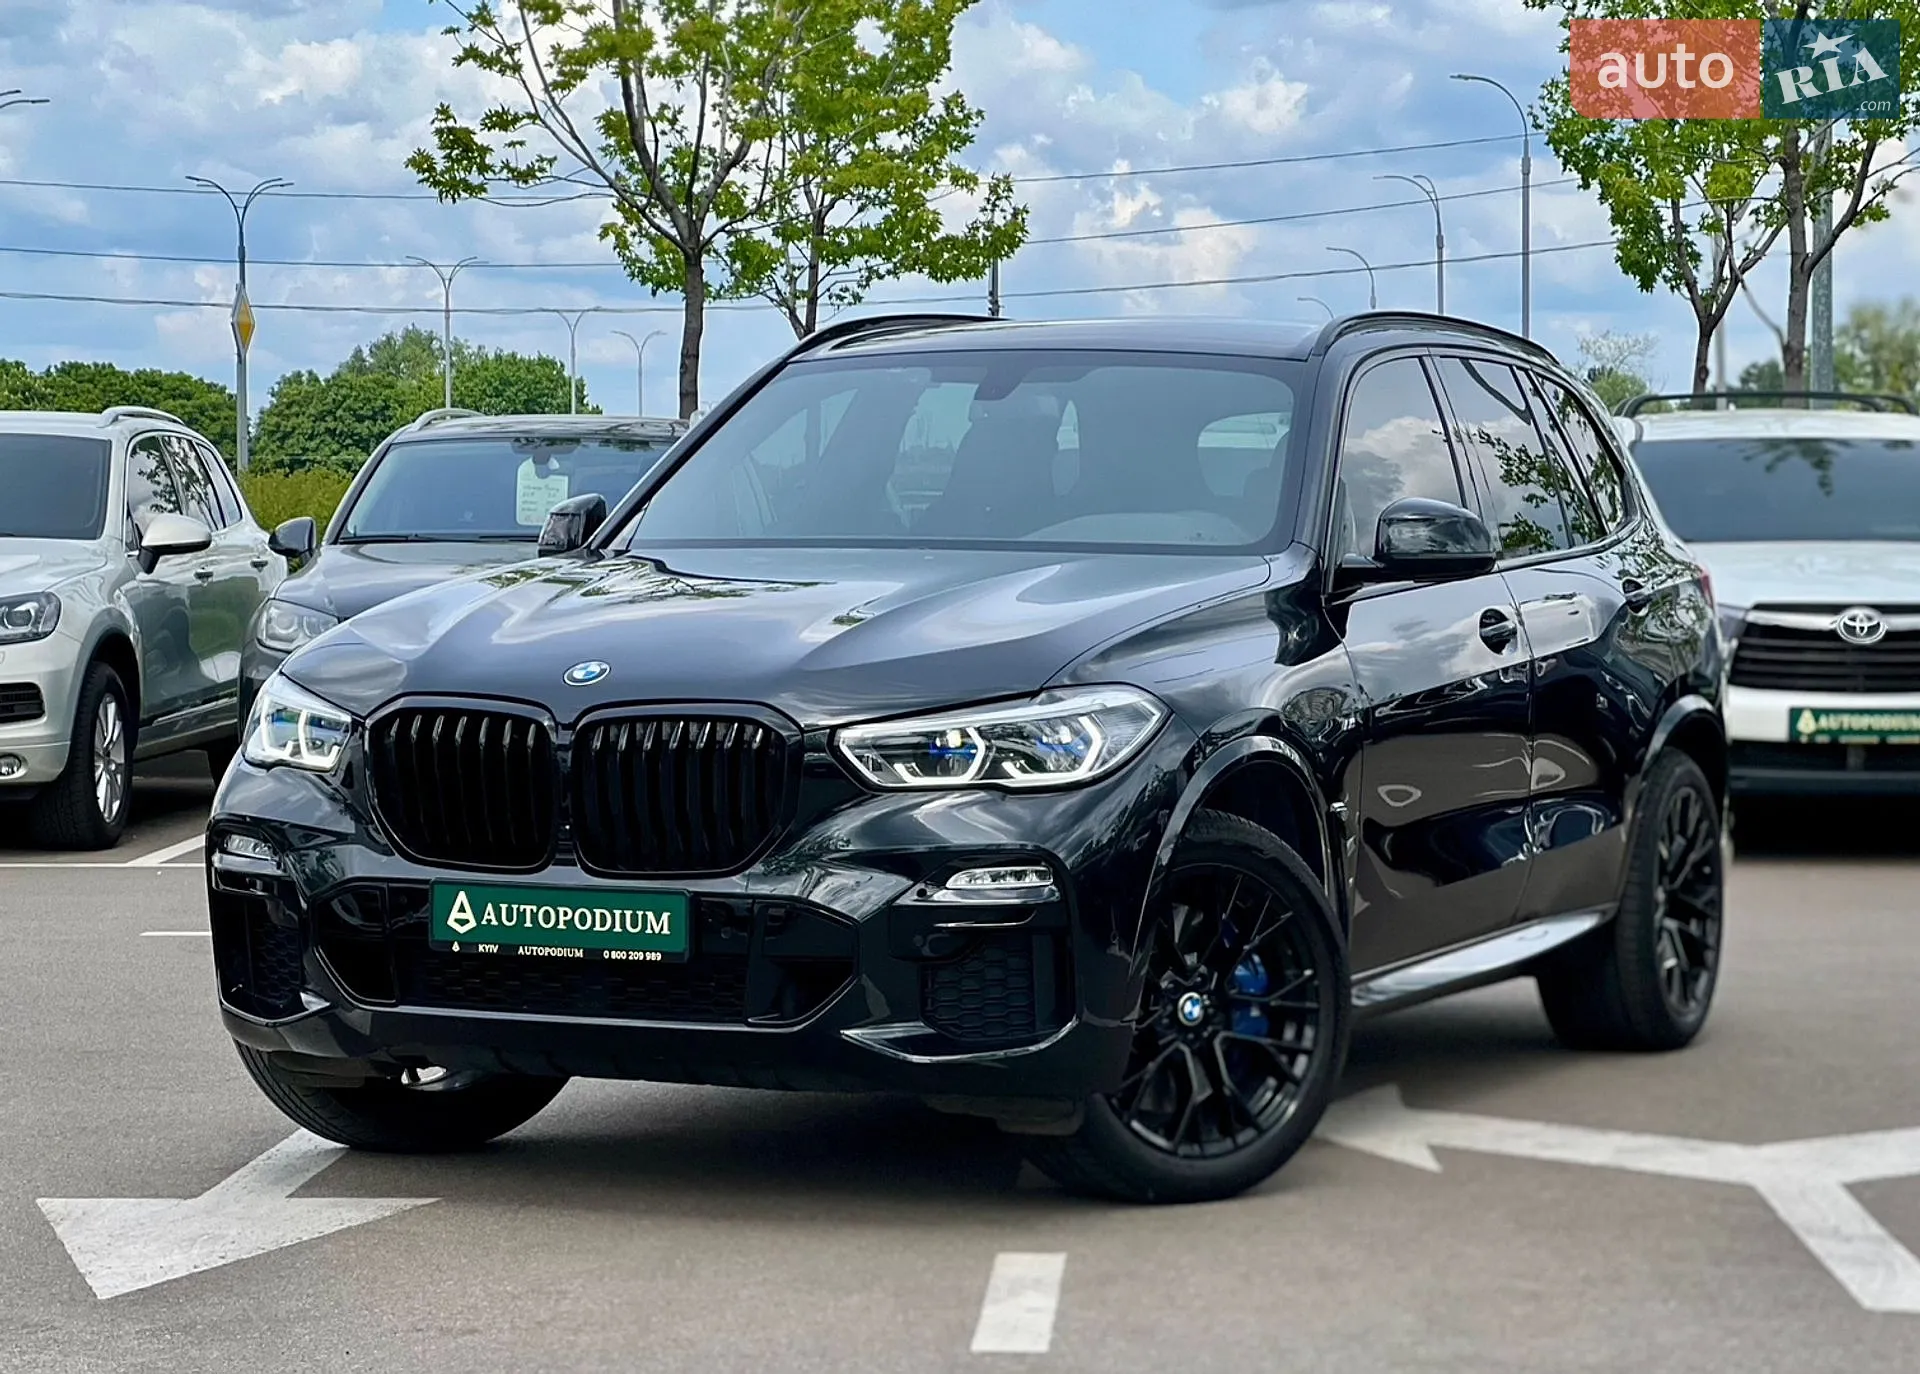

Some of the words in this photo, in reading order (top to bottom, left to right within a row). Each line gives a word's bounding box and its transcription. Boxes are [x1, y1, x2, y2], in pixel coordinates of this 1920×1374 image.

[481, 902, 671, 935] AUTOPODIUM
[478, 943, 499, 953] KYIV
[518, 945, 584, 958] AUTOPODIUM
[603, 950, 609, 959] 0
[610, 950, 627, 960] 800
[628, 951, 644, 960] 209
